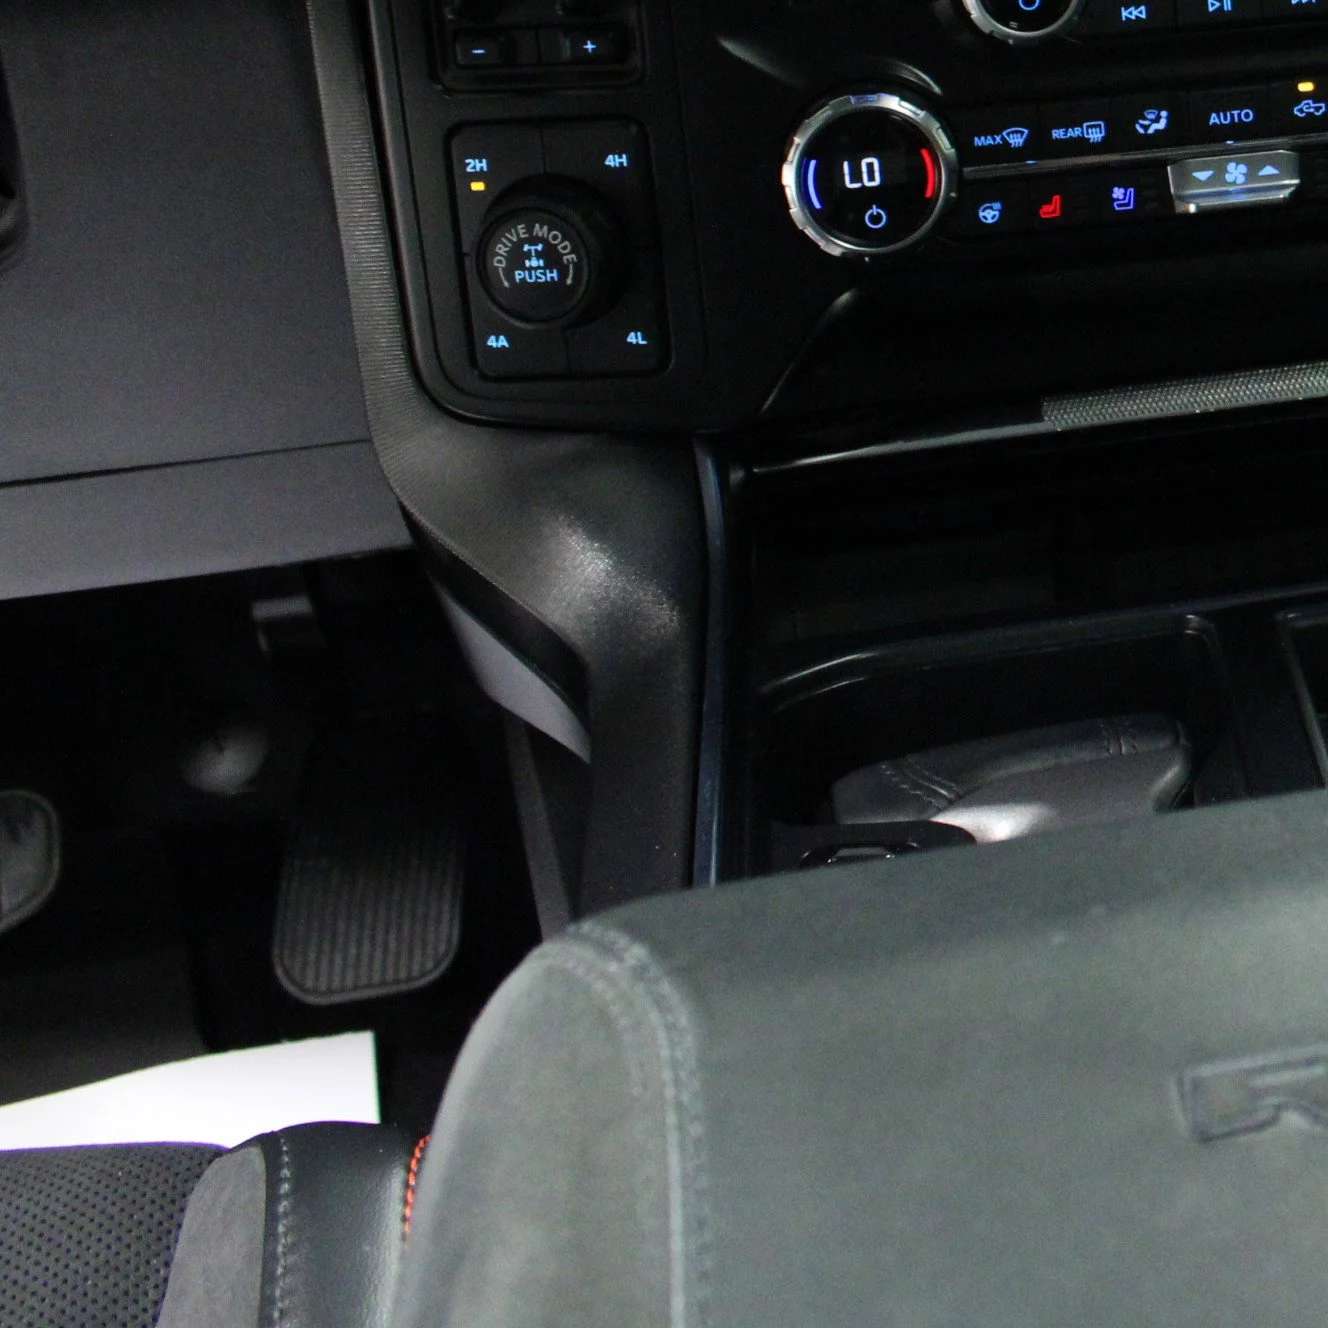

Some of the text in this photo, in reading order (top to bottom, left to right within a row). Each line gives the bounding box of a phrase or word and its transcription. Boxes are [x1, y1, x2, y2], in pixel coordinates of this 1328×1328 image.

[1209, 109, 1254, 125] AUTO
[974, 134, 1003, 147] MAX
[1052, 127, 1082, 140] REAR
[465, 158, 488, 173] 2H
[604, 154, 628, 169] 4H
[842, 156, 880, 189] LO
[493, 222, 578, 268] DRIVE MODE
[514, 269, 558, 283] PUSH
[486, 335, 510, 350] 4A
[626, 331, 648, 345] 4L
